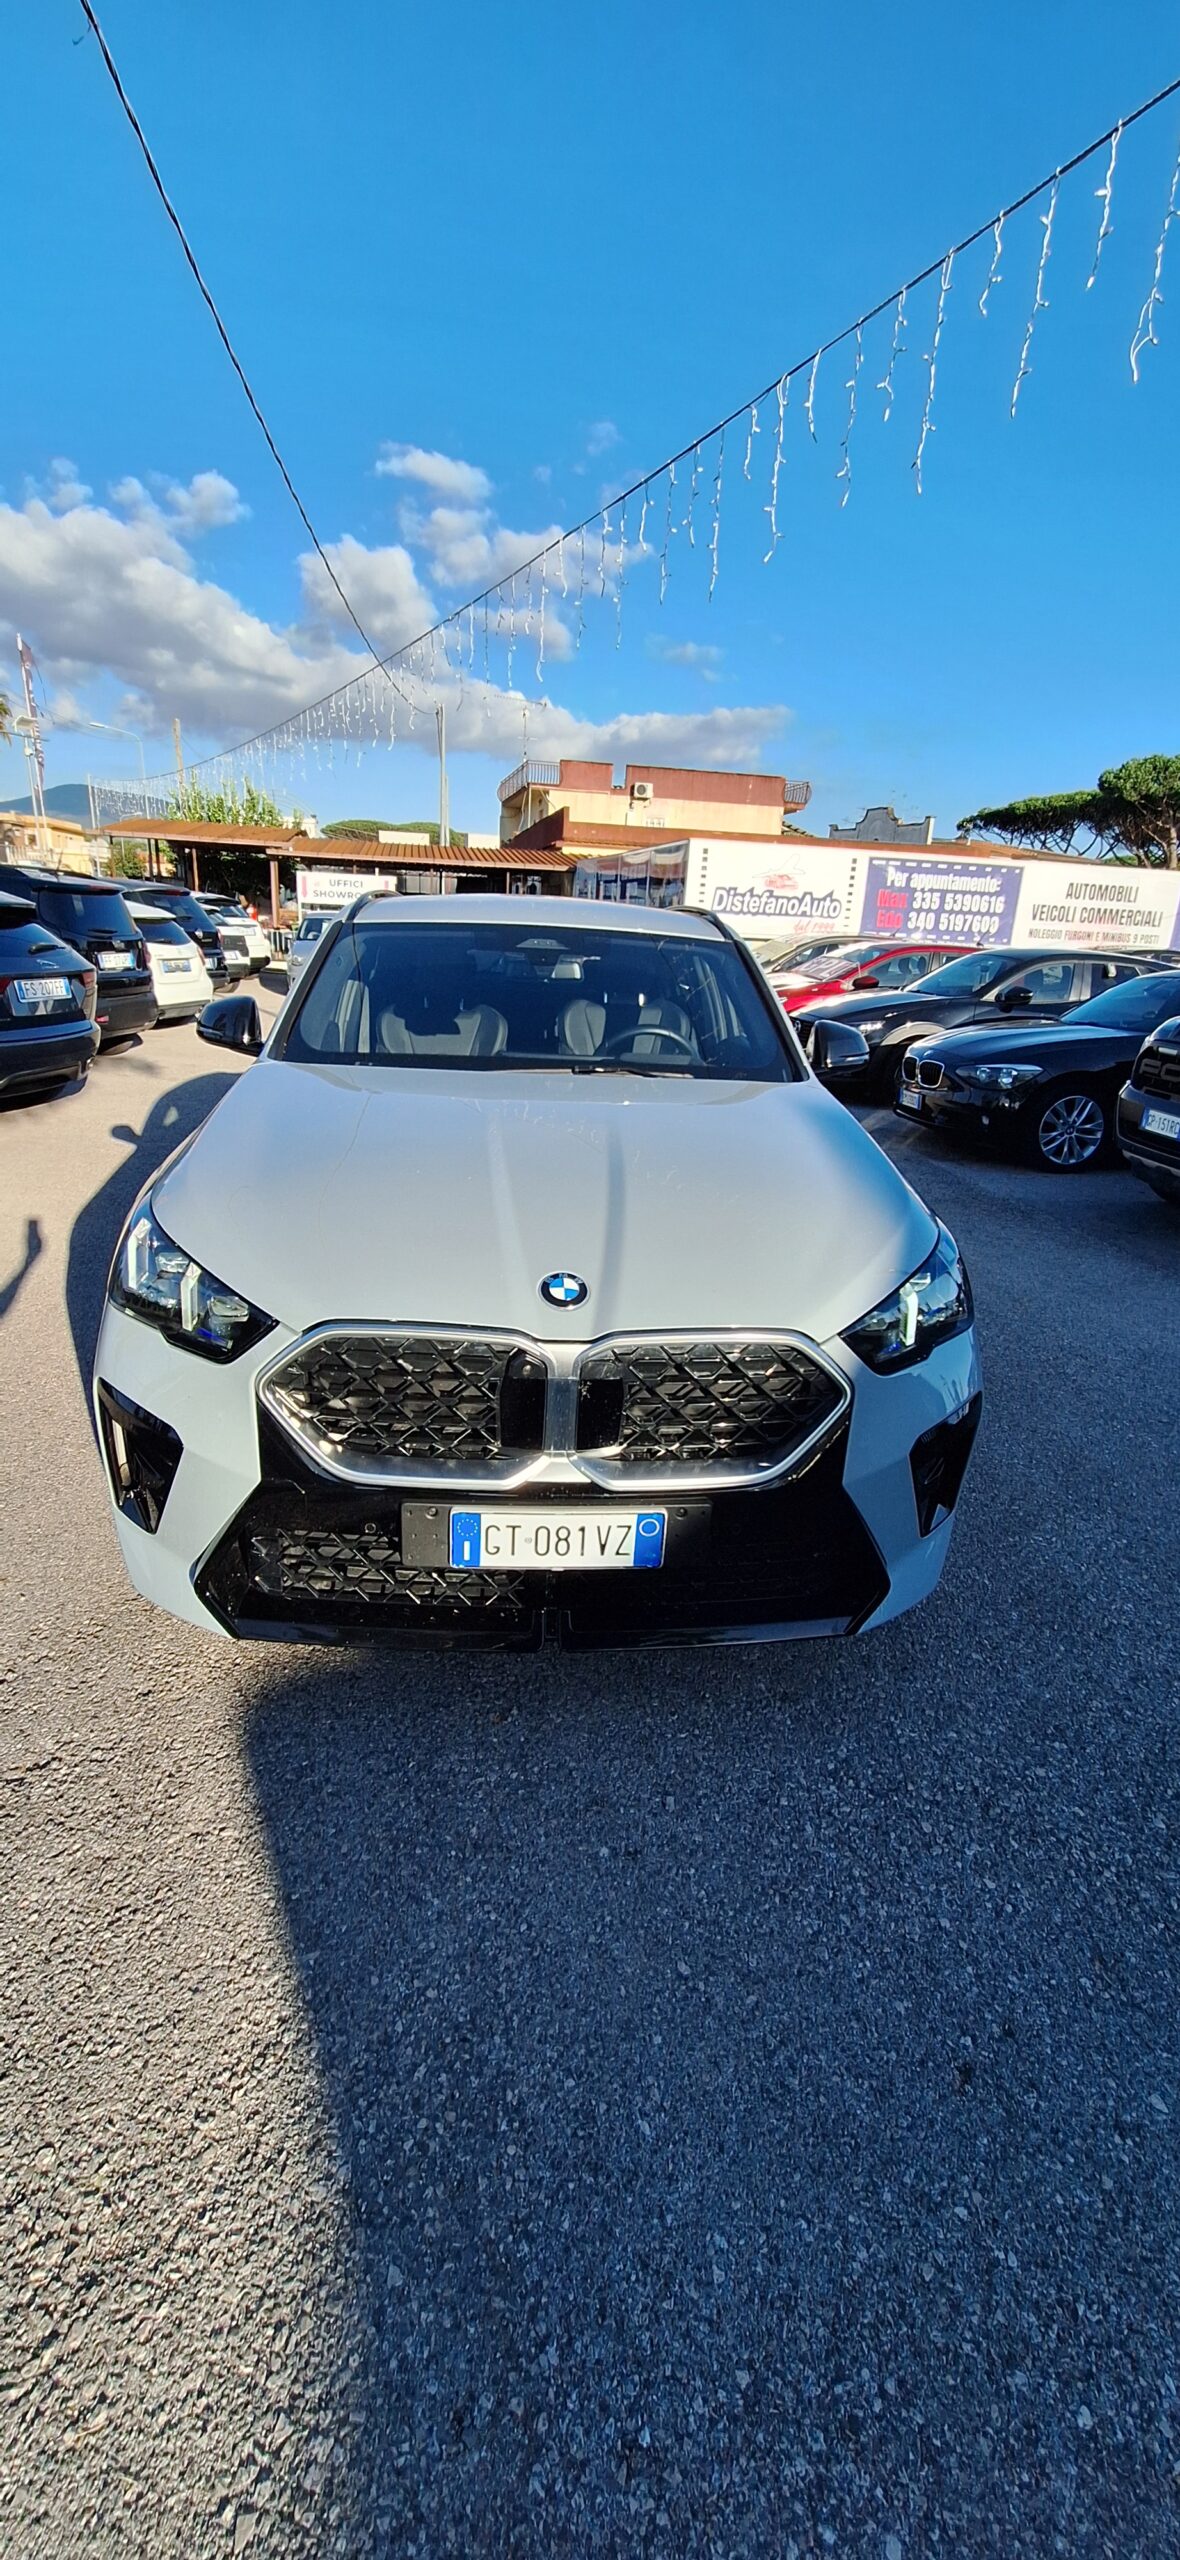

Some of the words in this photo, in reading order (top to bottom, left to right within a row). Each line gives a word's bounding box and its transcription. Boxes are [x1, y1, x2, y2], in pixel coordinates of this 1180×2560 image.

[329, 879, 363, 888] UFFICI
[886, 866, 910, 887] Per
[910, 873, 1002, 892] appuntamento:
[313, 889, 360, 899] SHOWRO
[712, 887, 841, 918] DistefanoAuto
[912, 891, 941, 910] 335
[944, 894, 1005, 913] 5390616
[1065, 882, 1139, 903] AUTOMOBILI
[907, 911, 935, 930] 340
[1032, 904, 1076, 922] VEICOLI
[1079, 907, 1163, 927] COMMERCIALI
[1028, 928, 1062, 940] NOLEGGIO
[1064, 930, 1094, 941] FURGONI
[1095, 931, 1100, 942] E
[1102, 932, 1131, 943] MINIBUS
[1133, 933, 1138, 943] 9
[1140, 934, 1159, 945] POSTI
[23, 982, 37, 995] FS
[485, 1525, 522, 1556] GT
[534, 1525, 632, 1556] 081VZ
